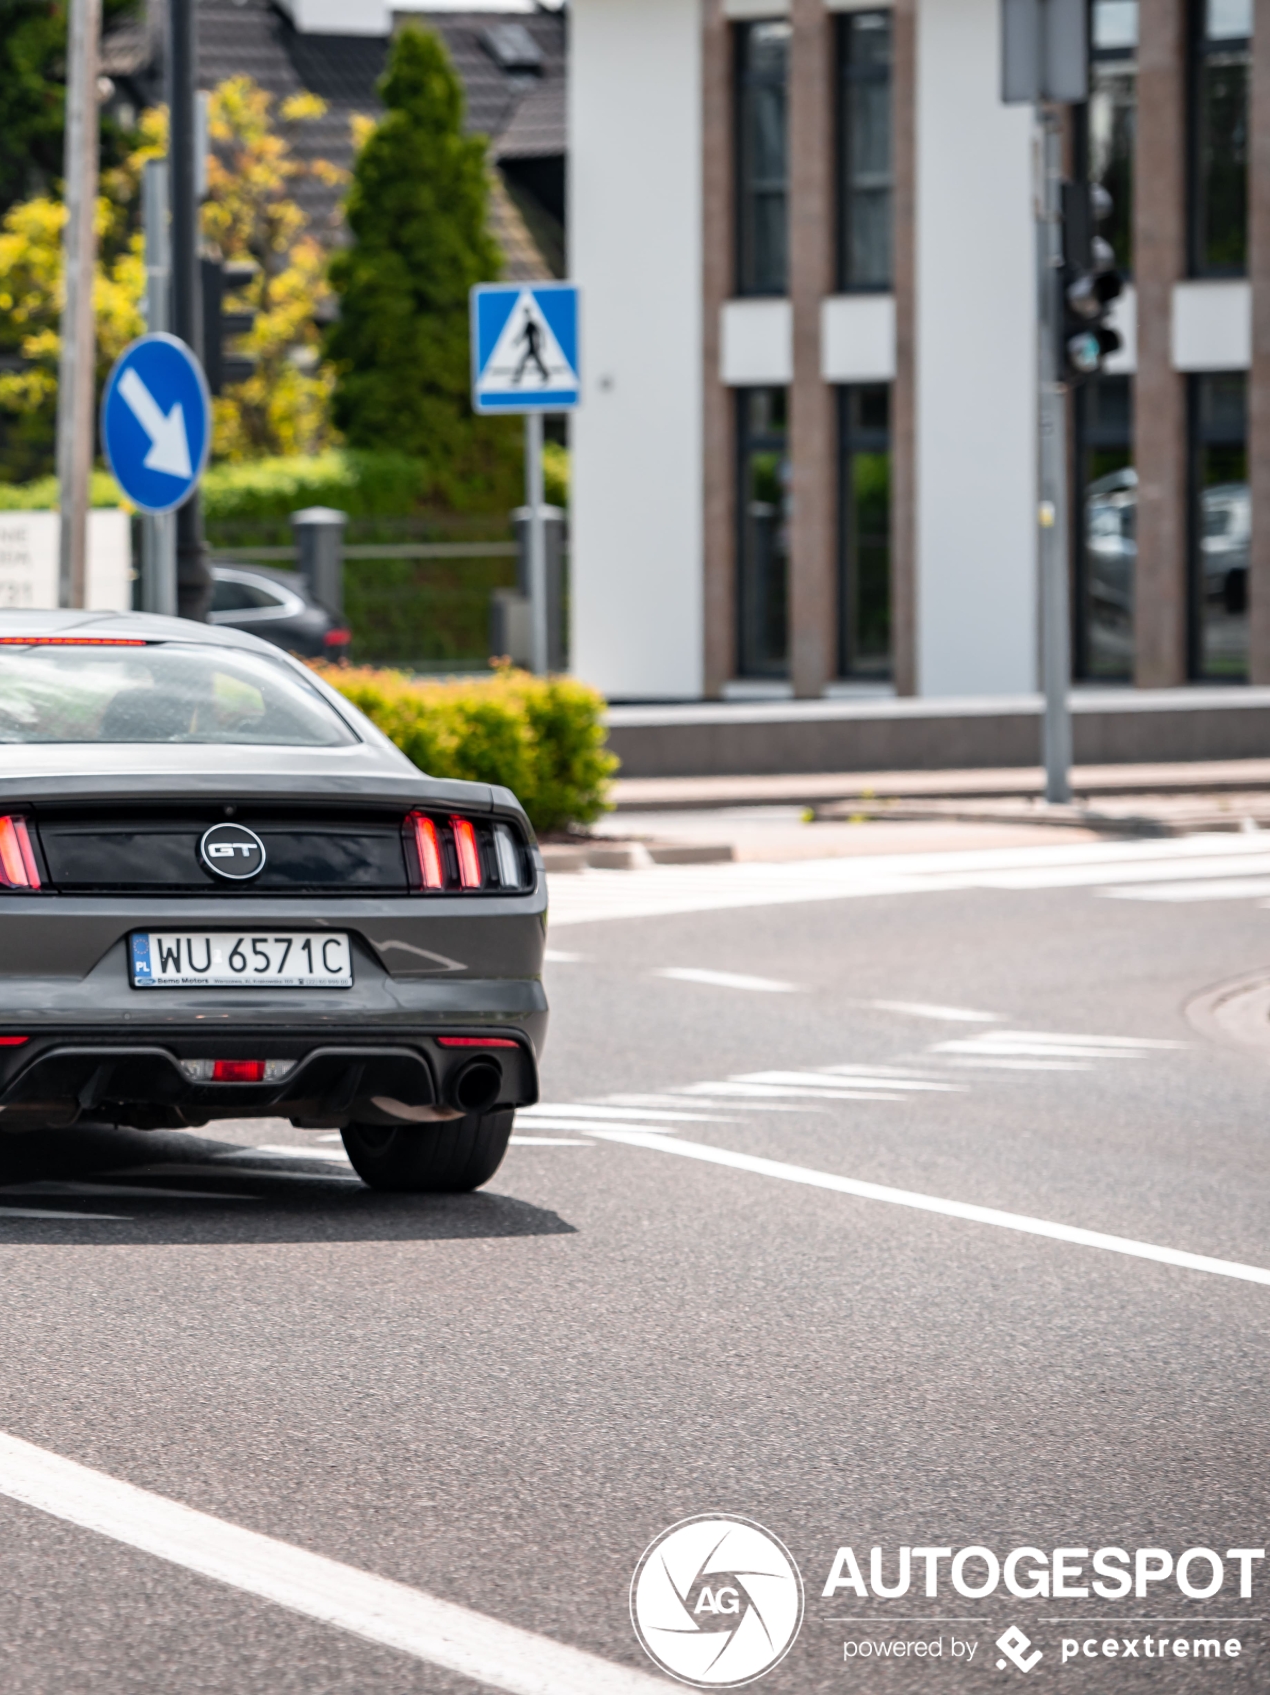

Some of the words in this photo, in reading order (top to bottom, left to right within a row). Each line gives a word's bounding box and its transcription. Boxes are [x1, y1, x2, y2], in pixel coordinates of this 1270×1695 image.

[207, 843, 257, 857] GT
[157, 938, 212, 973] WU
[229, 938, 343, 974] 6571C
[136, 961, 150, 972] PL
